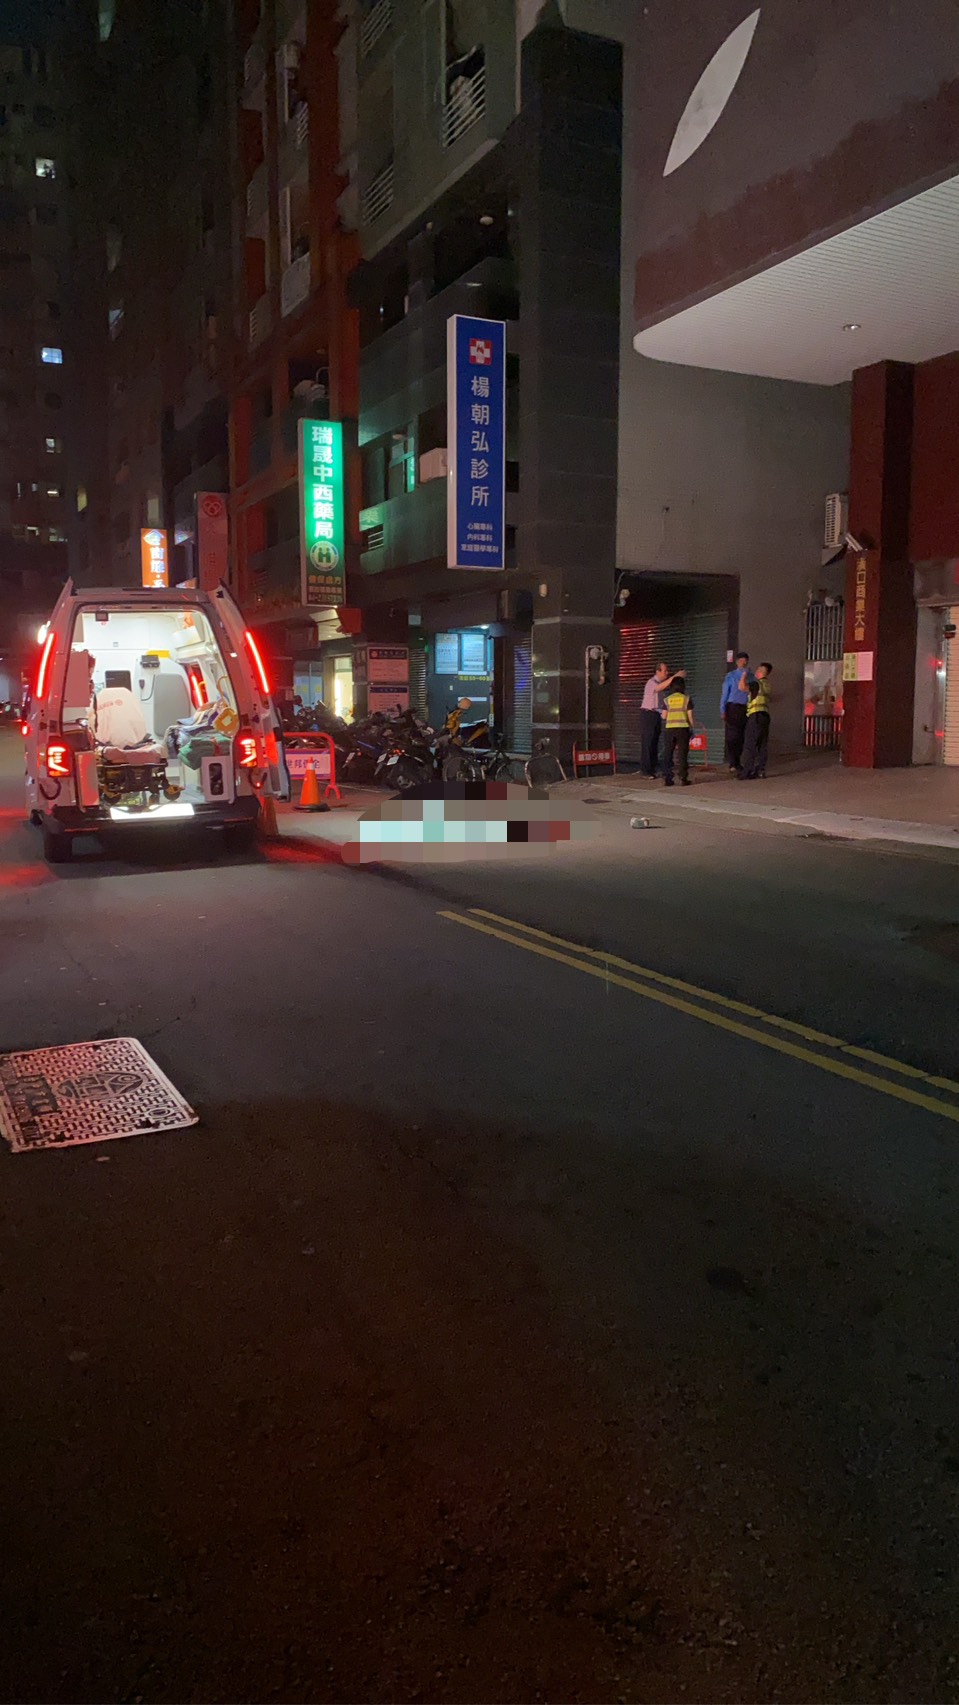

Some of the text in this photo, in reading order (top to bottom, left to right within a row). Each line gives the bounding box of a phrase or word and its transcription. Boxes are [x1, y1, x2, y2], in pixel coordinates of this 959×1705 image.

[312, 426, 334, 539] 瑞晟中西藥局
[470, 375, 490, 507] 楊朝弘診所
